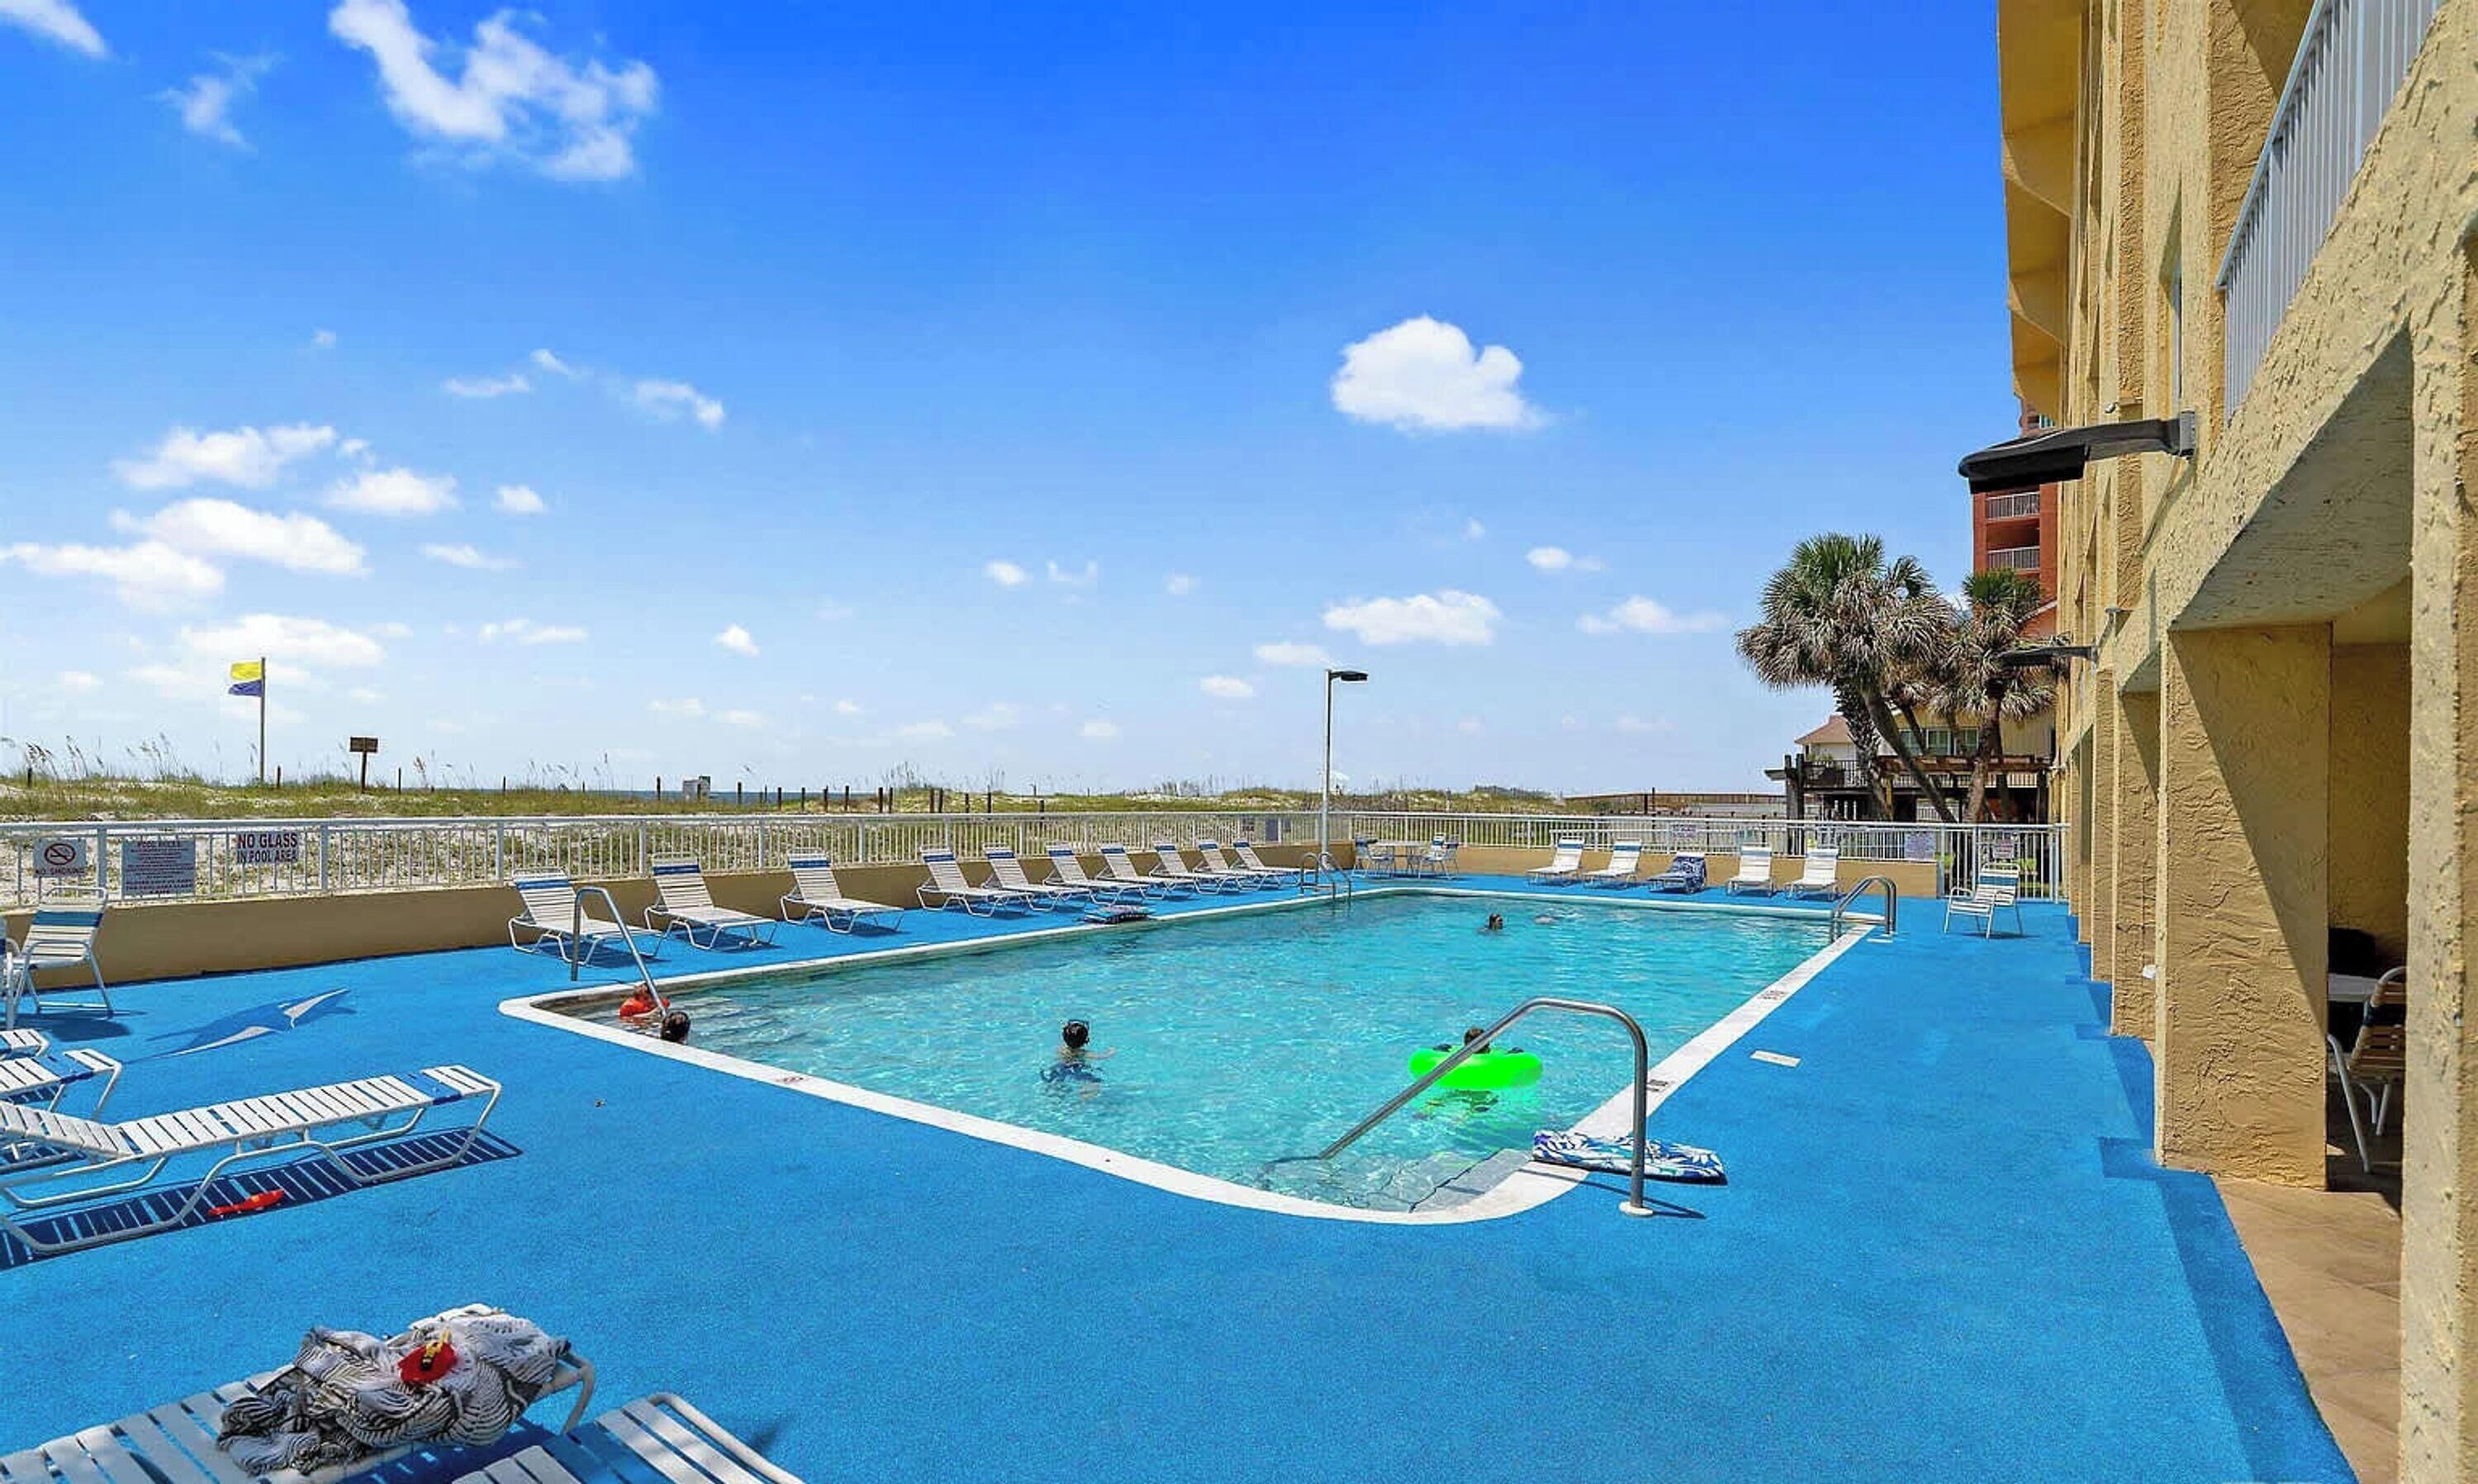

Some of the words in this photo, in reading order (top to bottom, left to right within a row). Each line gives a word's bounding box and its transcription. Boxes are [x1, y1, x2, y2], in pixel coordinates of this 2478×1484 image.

[238, 833, 254, 849] NO
[260, 832, 298, 848] GLASS
[237, 851, 246, 864] IN
[249, 850, 271, 863] POOL
[275, 849, 298, 862] AREA
